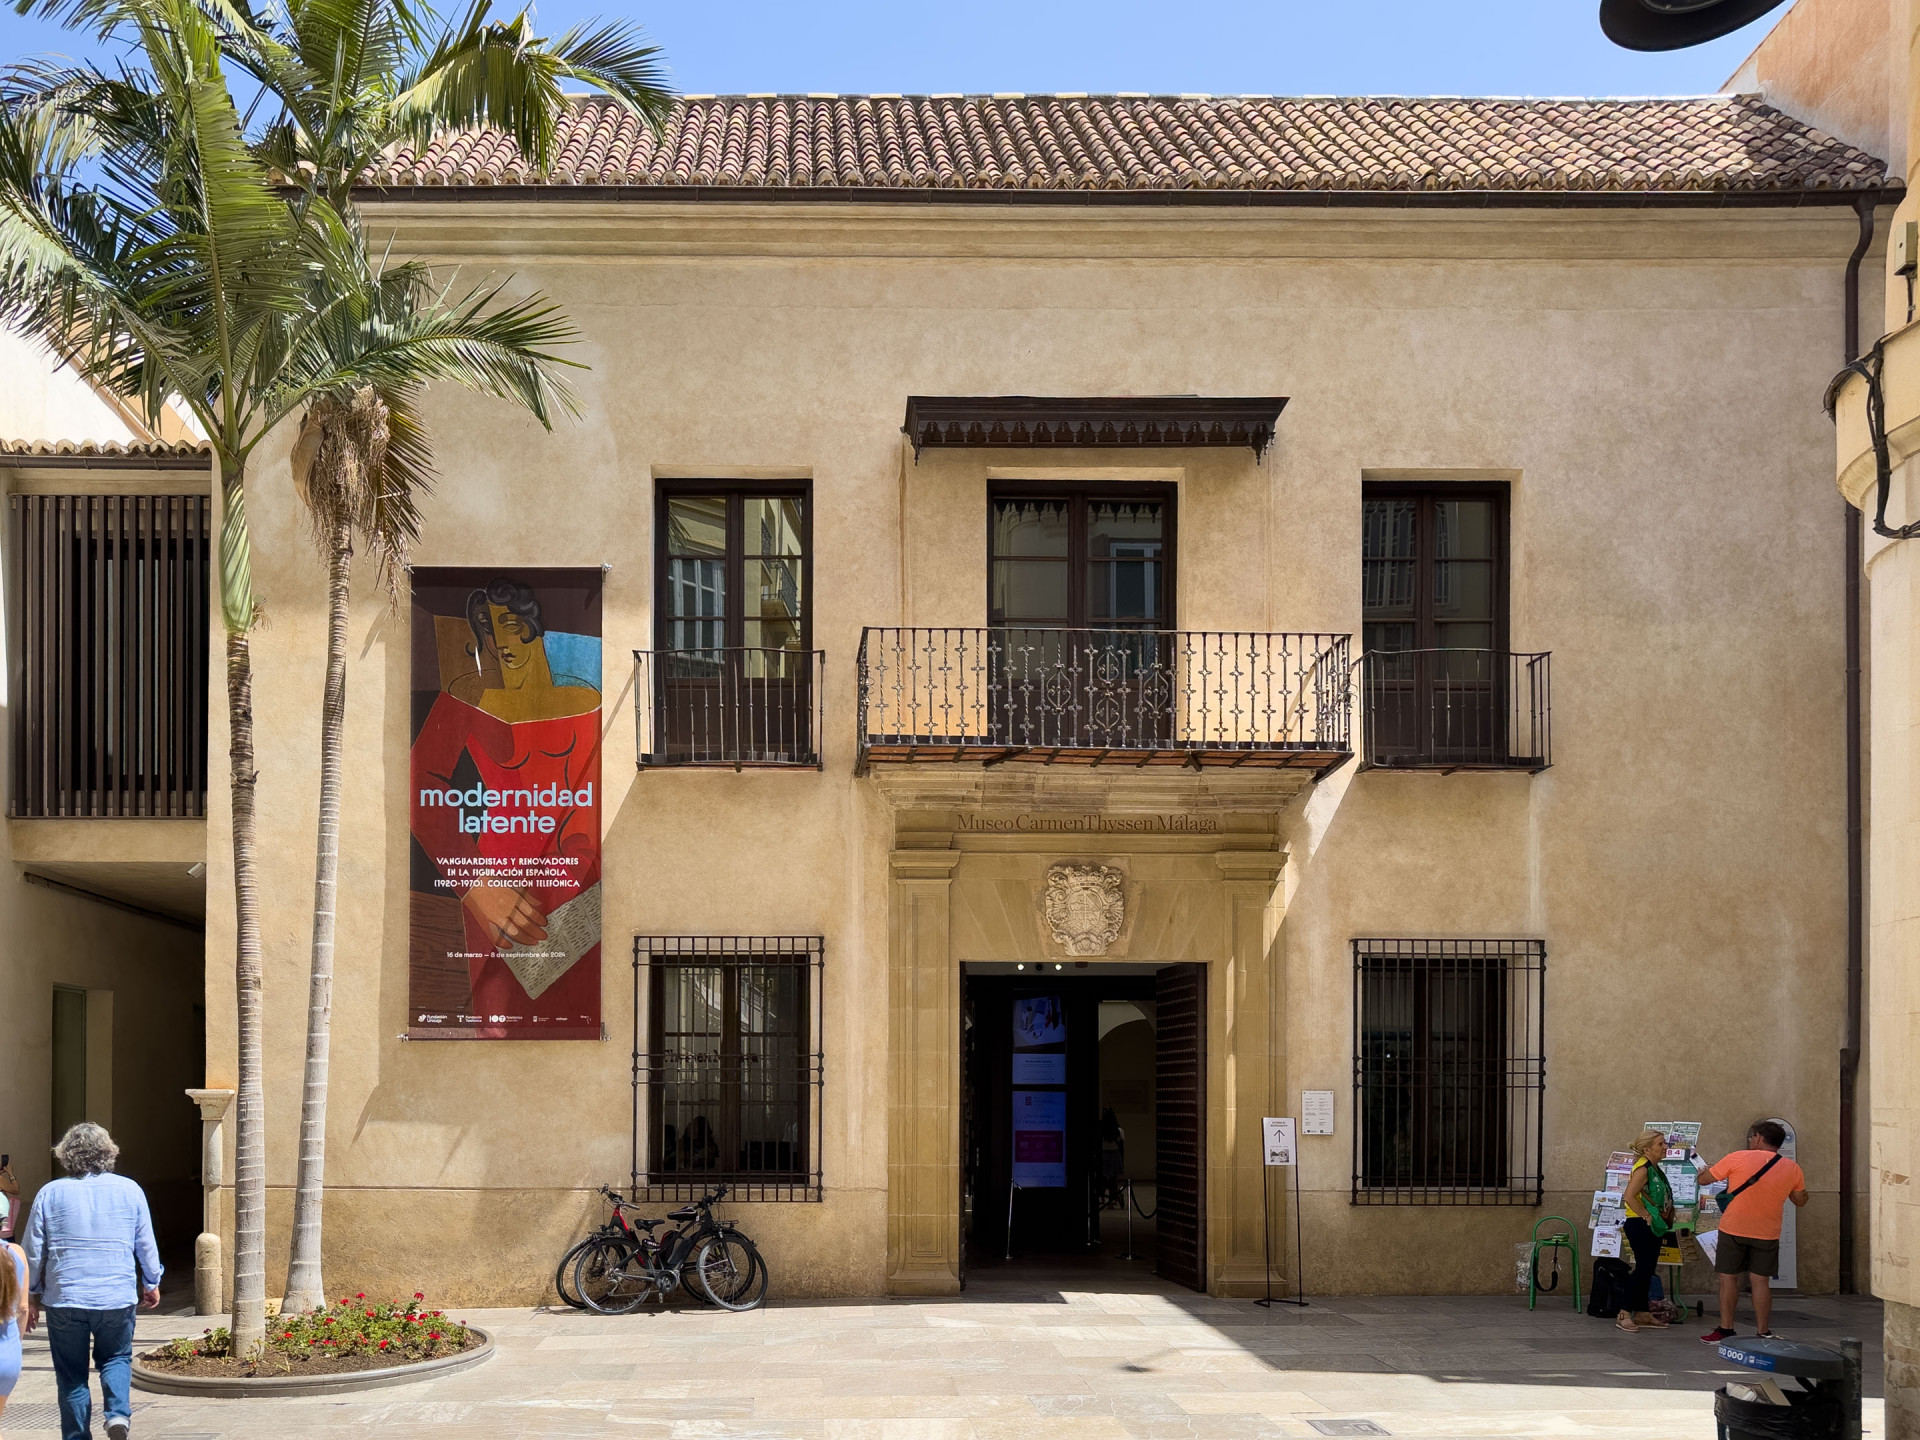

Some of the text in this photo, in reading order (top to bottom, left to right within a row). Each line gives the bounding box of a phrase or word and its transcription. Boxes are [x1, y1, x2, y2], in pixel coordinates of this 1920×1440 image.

[419, 782, 593, 807] modernidad
[458, 808, 556, 834] latente
[957, 814, 1217, 834] Museo Carmen Thyssen Málaga
[436, 857, 579, 866] VANGUARDISTAS Y RENOVADORES
[447, 867, 567, 877] EN LA FIGURACIÓN ESPAÑOLA
[487, 877, 533, 888] COLECCIÓN
[536, 877, 580, 888] TELEFÓNICA
[505, 951, 540, 960] septiembre
